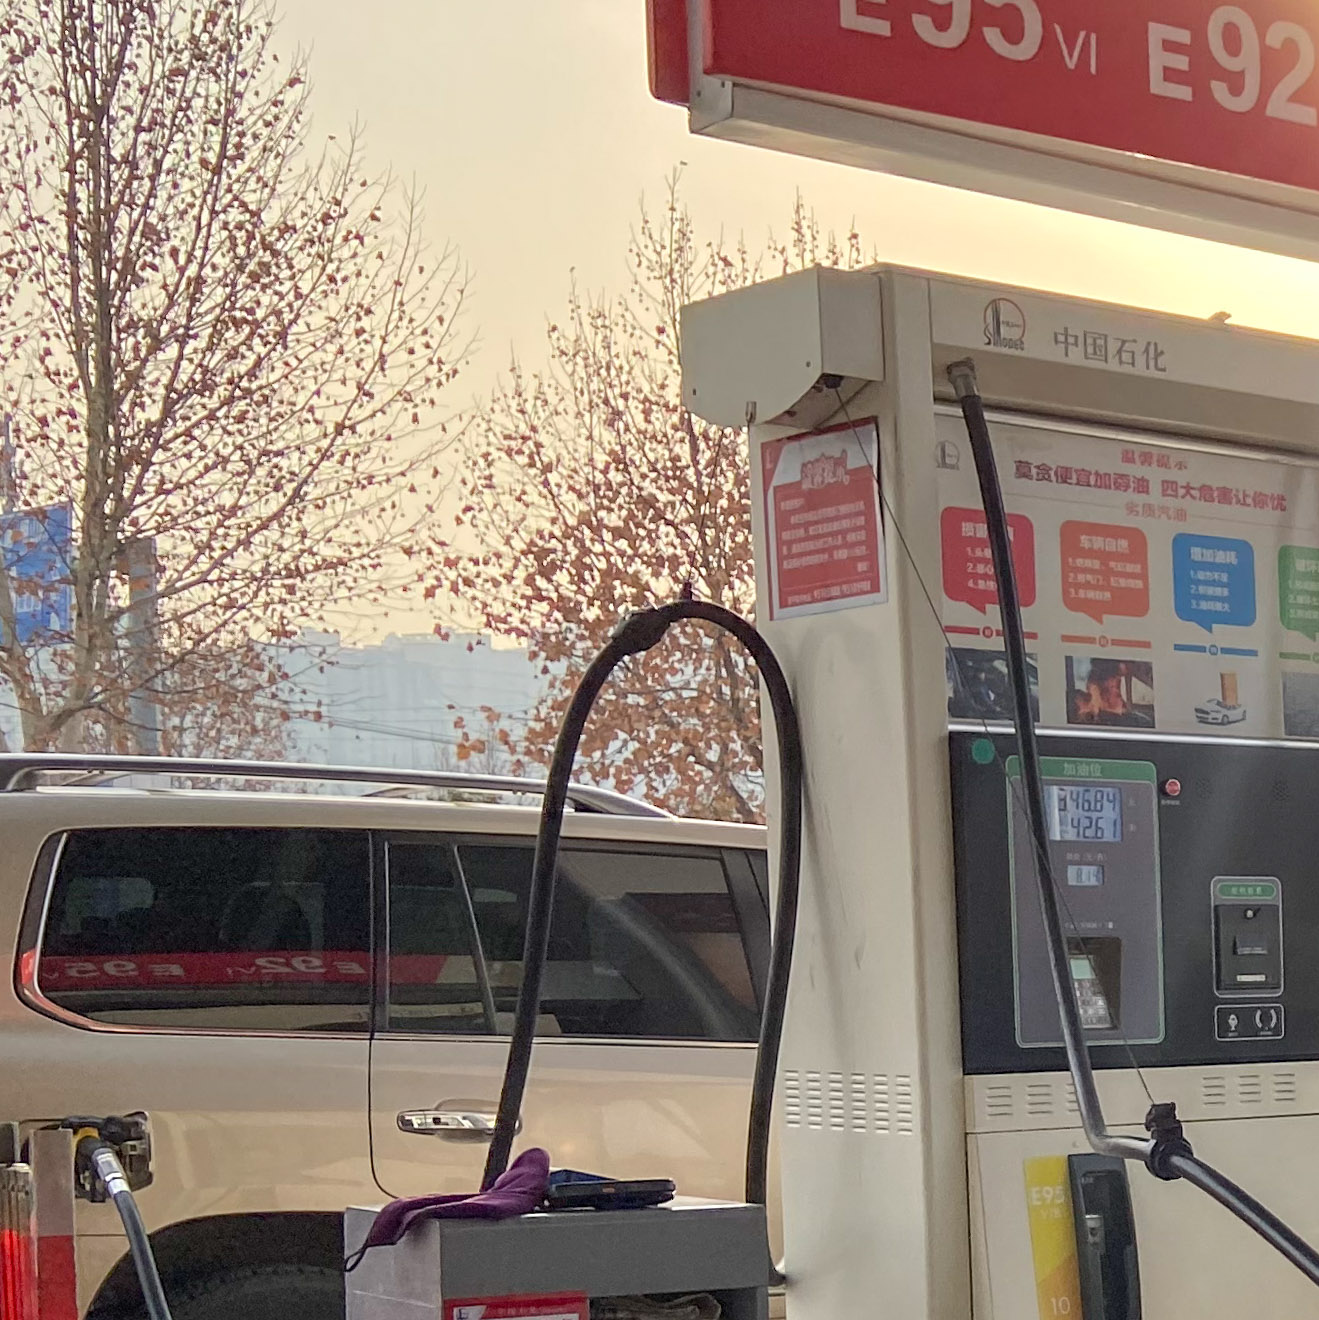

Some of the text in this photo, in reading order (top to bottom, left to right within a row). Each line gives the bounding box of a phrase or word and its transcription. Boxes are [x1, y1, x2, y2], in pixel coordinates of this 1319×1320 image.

[1053, 306, 1168, 373] 中国石化
[1121, 448, 1188, 471] 温馨提示
[1125, 502, 1188, 523] 劣质汽油
[1079, 534, 1130, 554] 车辆自燃
[1063, 762, 1103, 777] 加油位
[1070, 816, 1118, 840] 42.61
[1031, 1186, 1065, 1206] E95
[1051, 1296, 1070, 1316] 10
